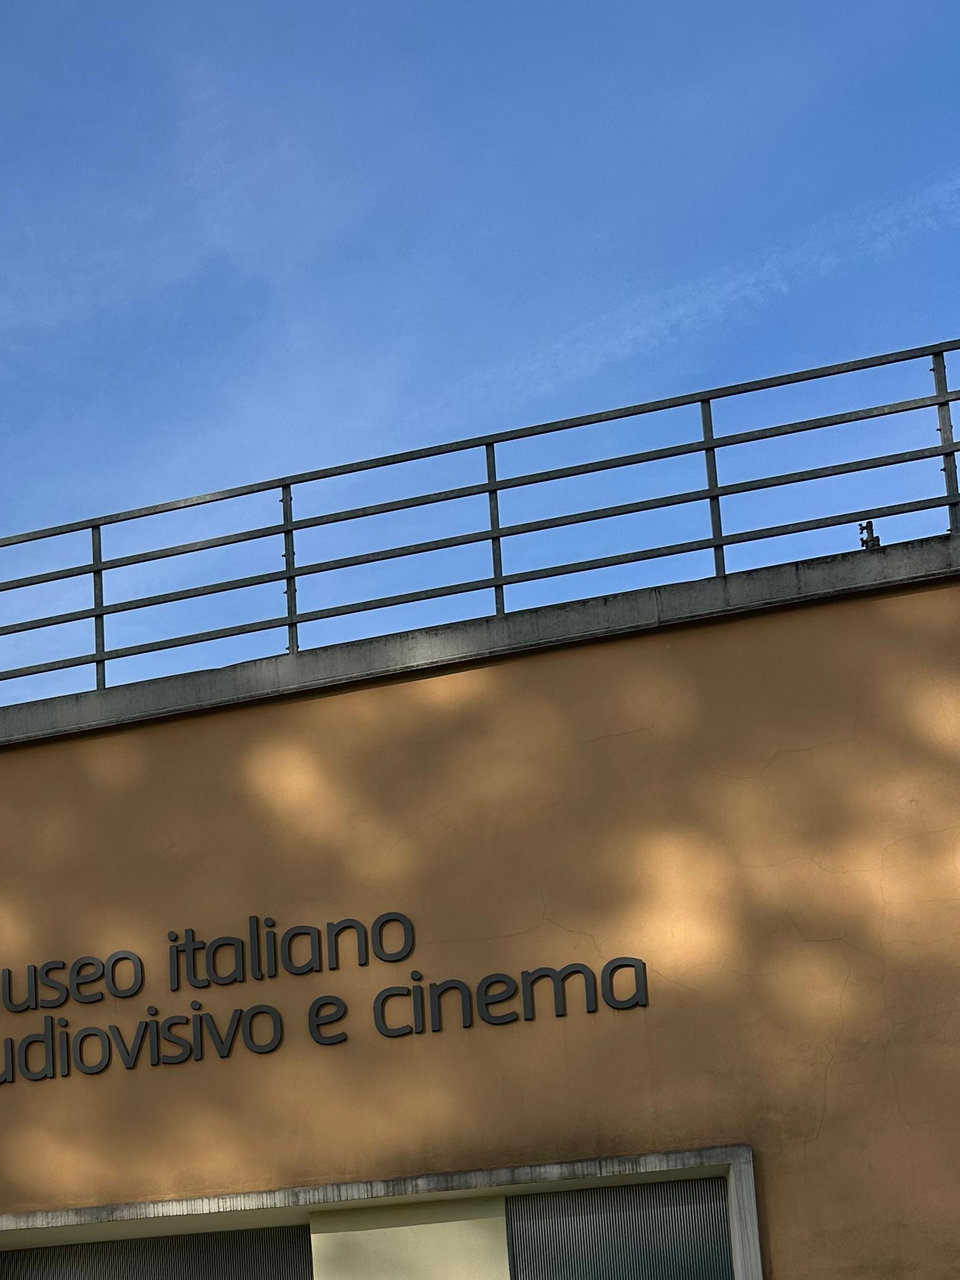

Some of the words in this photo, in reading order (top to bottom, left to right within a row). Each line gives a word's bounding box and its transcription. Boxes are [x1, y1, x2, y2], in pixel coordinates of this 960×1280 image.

[168, 911, 415, 991] italiano
[307, 994, 347, 1046] e
[373, 956, 647, 1038] cinema
